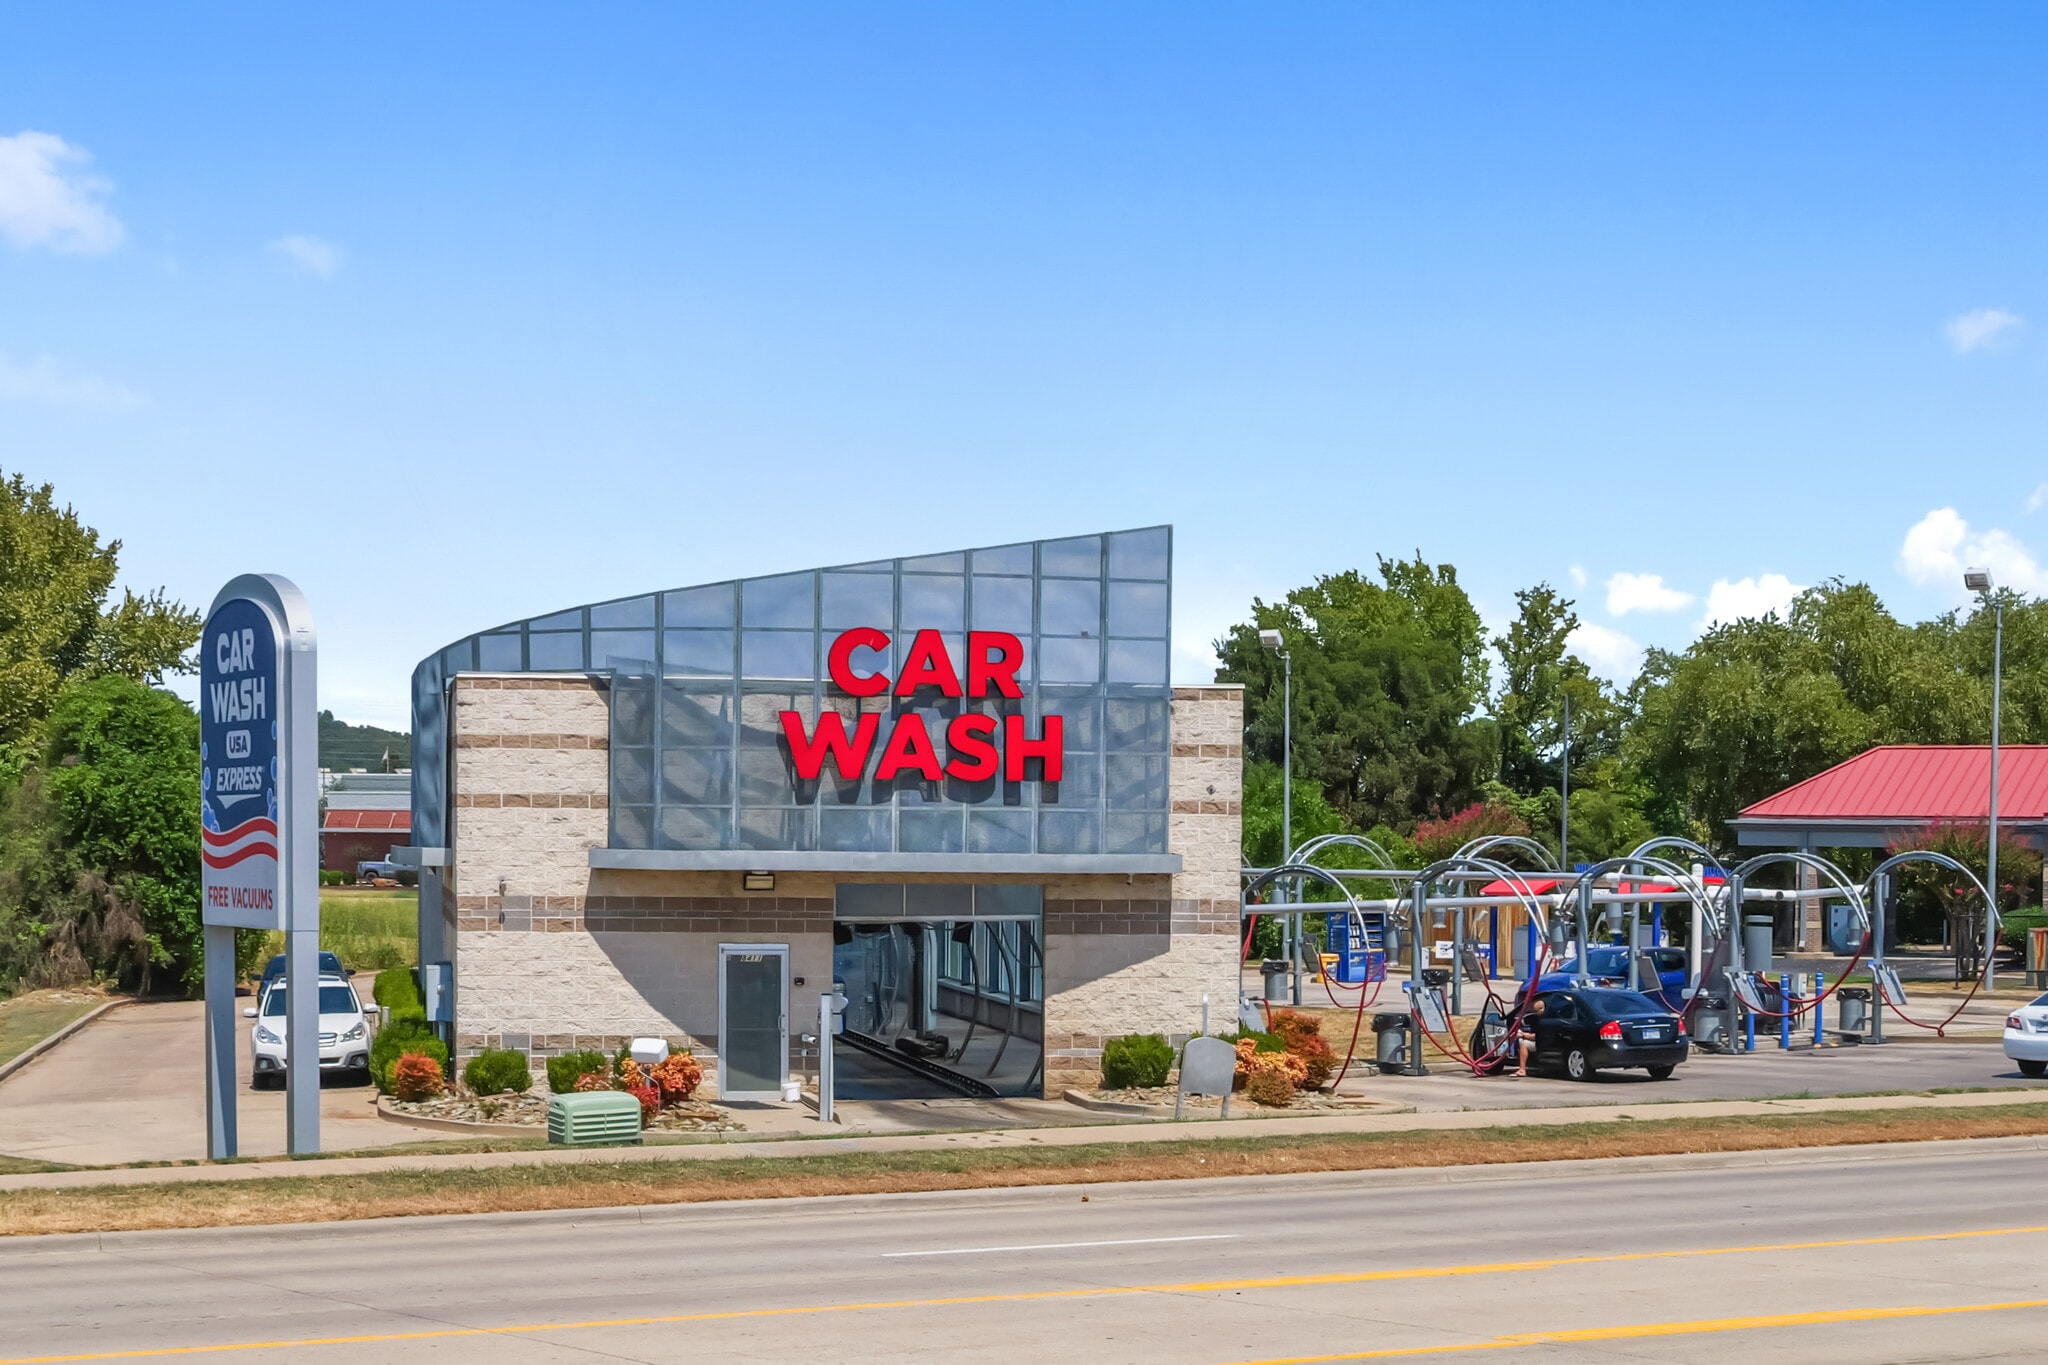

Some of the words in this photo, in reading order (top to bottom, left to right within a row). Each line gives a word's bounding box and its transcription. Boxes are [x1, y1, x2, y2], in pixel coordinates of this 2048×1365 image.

[217, 628, 255, 675] CAR
[828, 626, 1025, 699] CAR
[210, 676, 266, 724] WASH
[228, 734, 248, 754] USA
[778, 711, 1063, 783] WASH
[216, 765, 262, 792] EXPRESS
[208, 885, 229, 908] FREE
[230, 887, 274, 911] VACUUMS
